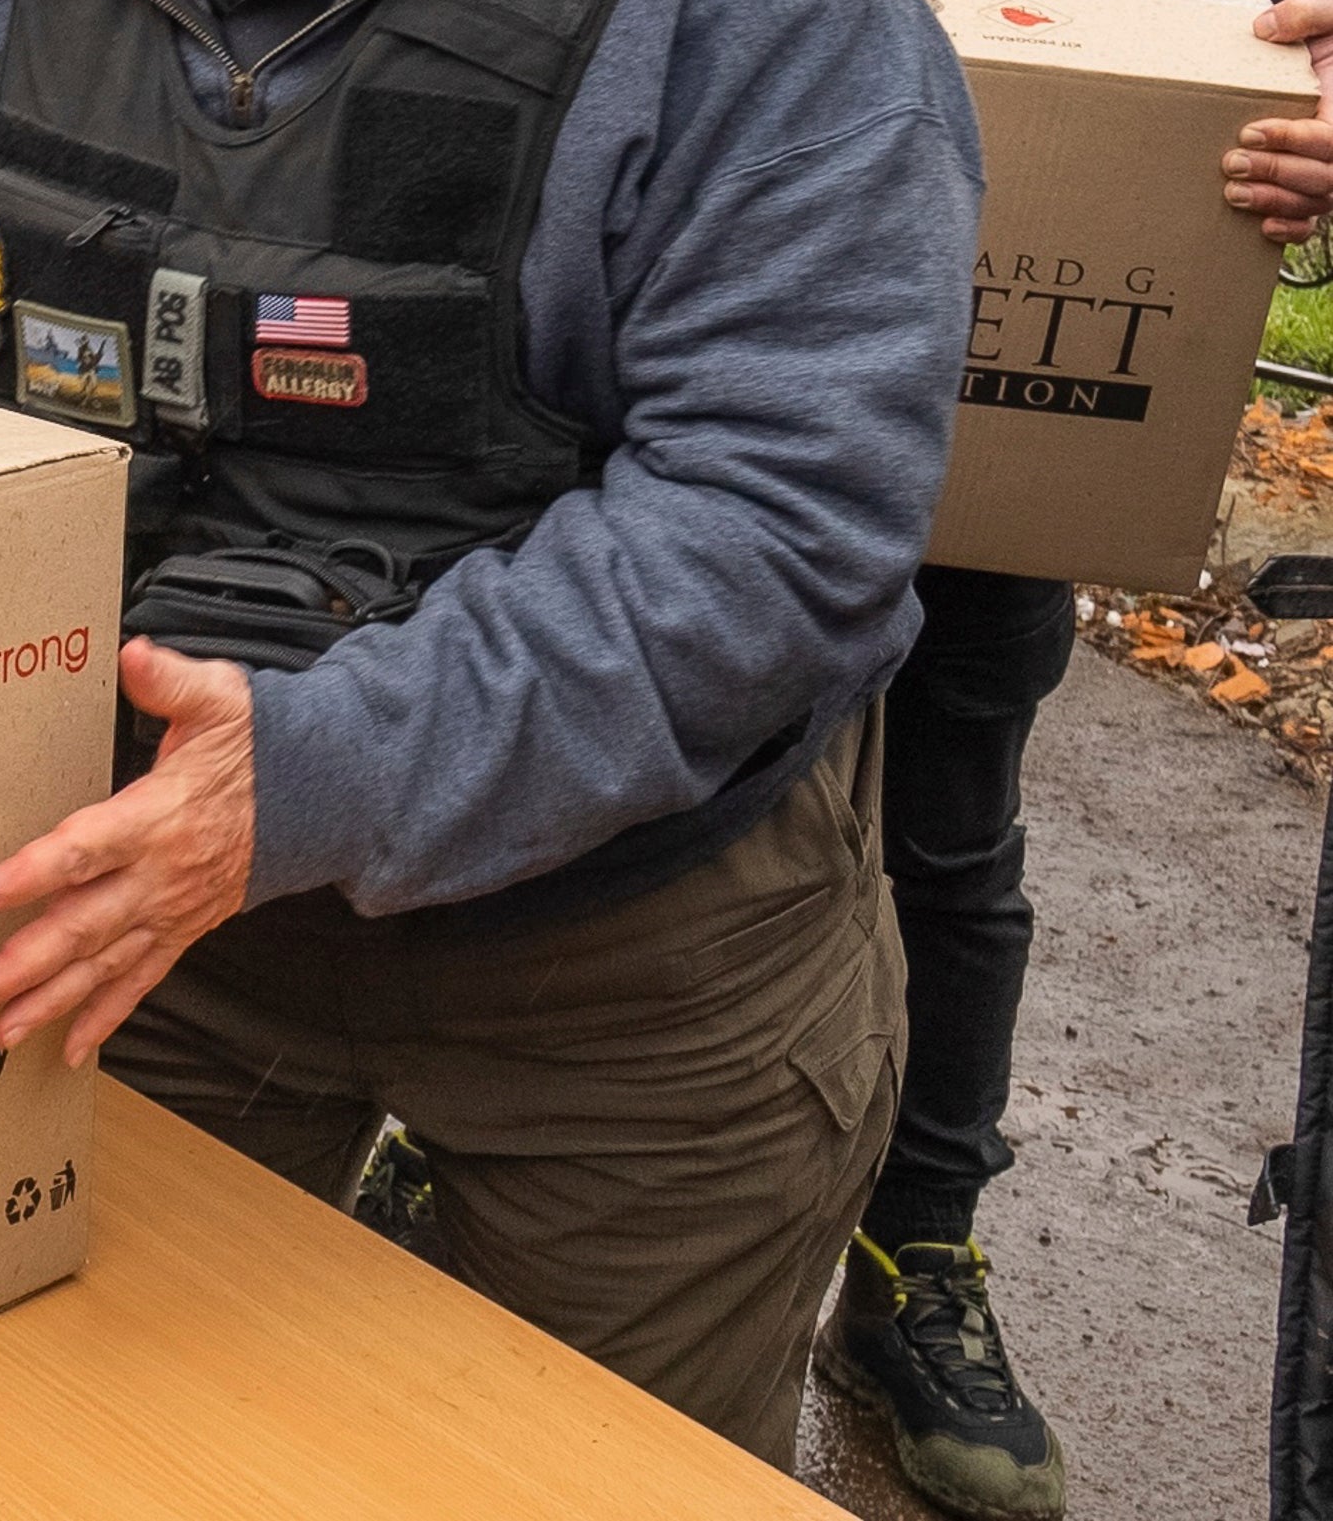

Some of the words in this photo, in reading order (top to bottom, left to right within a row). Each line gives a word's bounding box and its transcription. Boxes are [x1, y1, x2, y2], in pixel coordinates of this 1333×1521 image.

[1125, 266, 1176, 297] G.
[156, 290, 187, 345] POS
[152, 356, 184, 396] AB
[266, 374, 356, 402] ALLERGY
